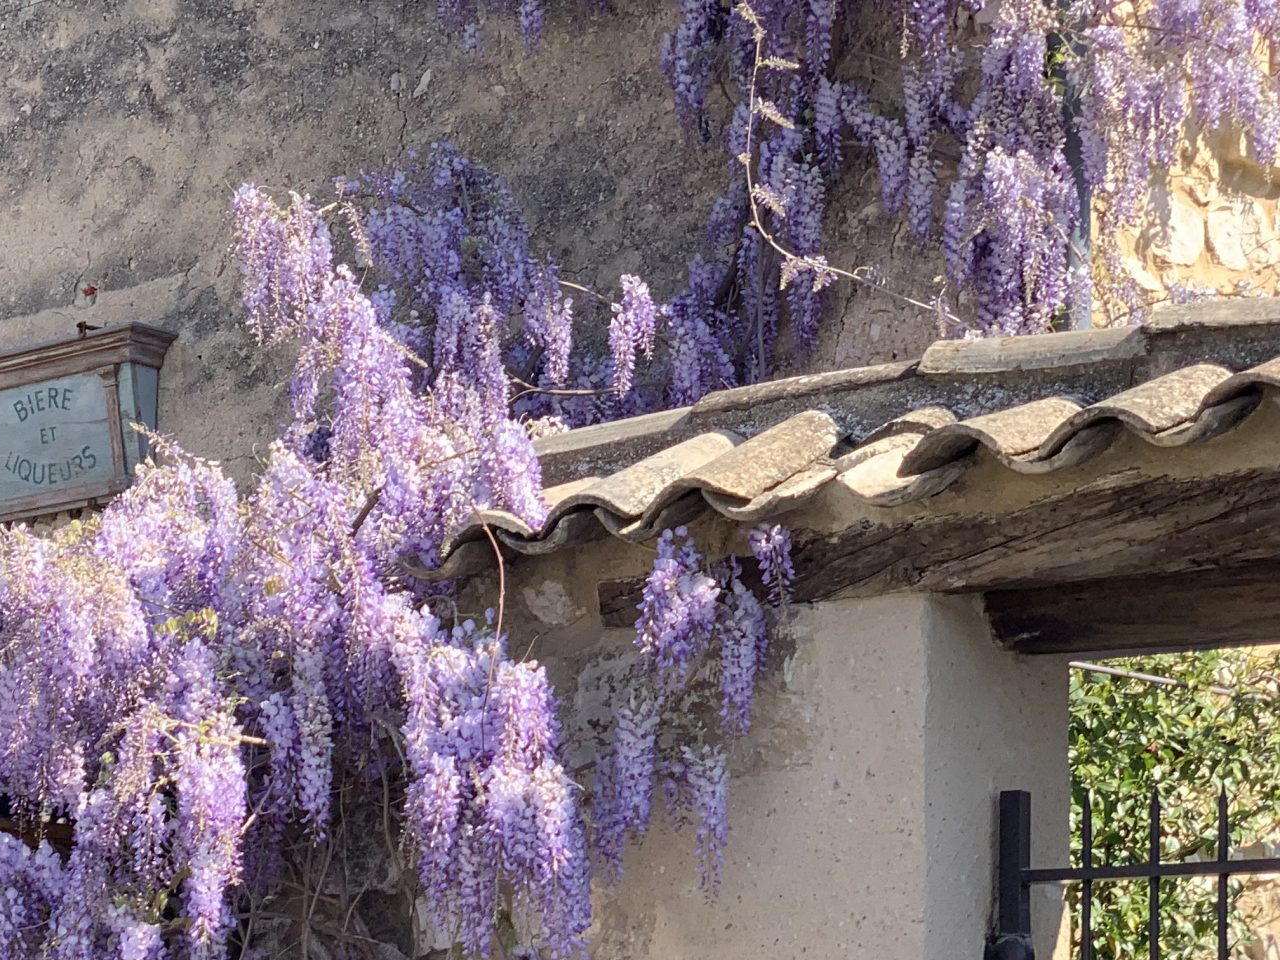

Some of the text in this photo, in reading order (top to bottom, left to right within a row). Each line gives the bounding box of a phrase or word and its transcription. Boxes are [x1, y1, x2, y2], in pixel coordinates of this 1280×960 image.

[13, 387, 73, 422] BIERE
[39, 427, 57, 445] ET
[5, 446, 98, 486] LIQUEURS
